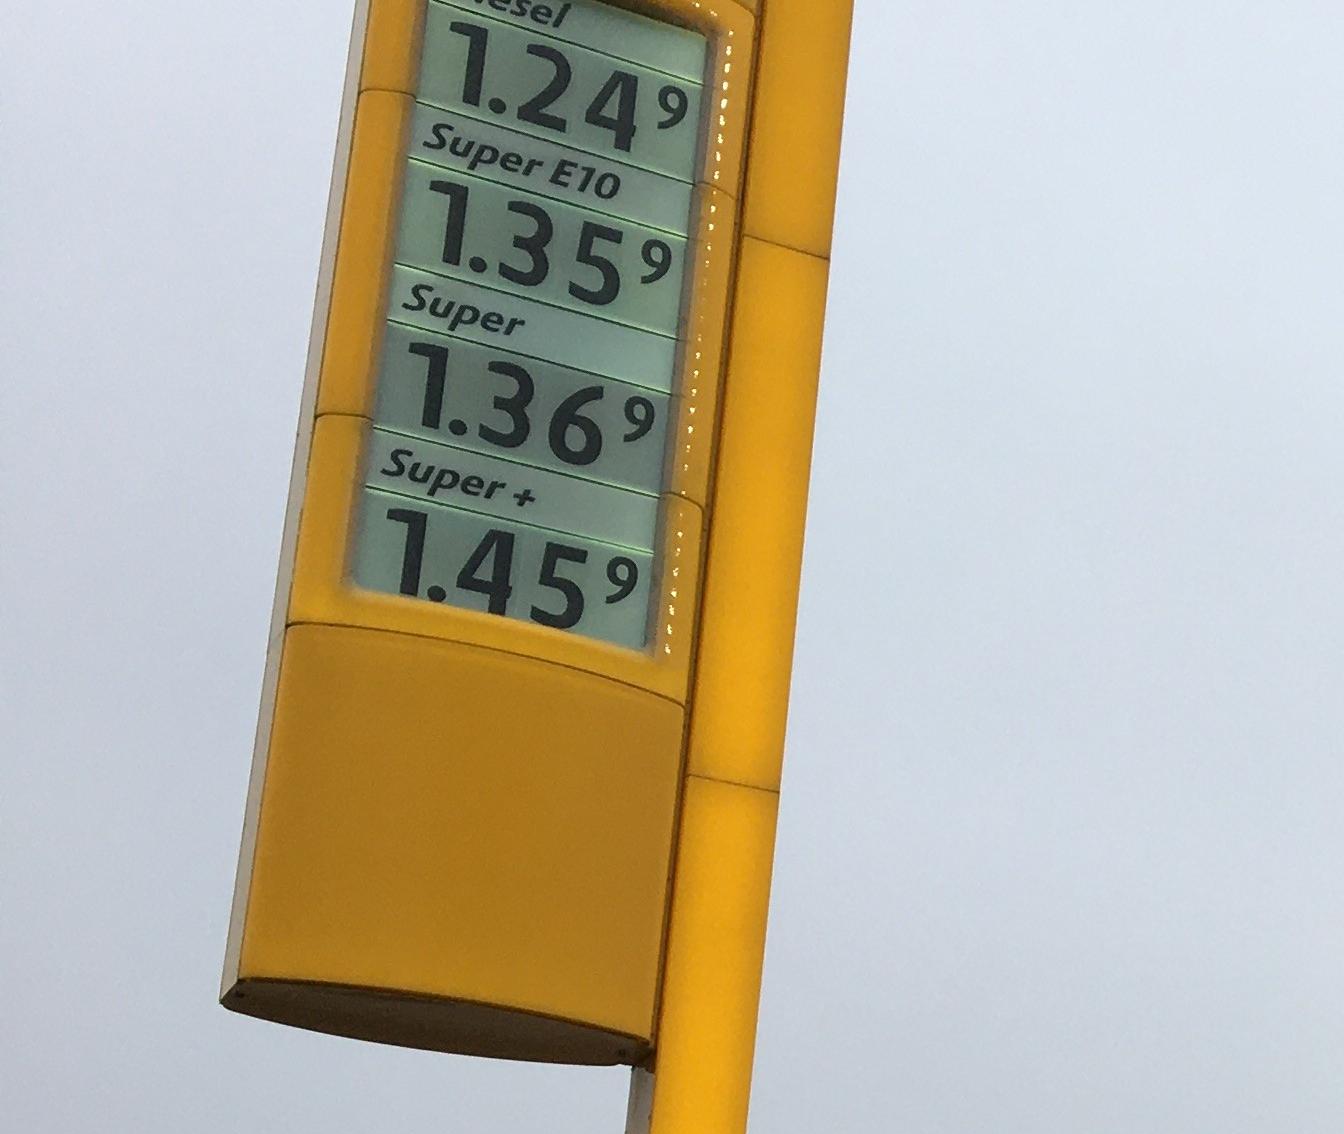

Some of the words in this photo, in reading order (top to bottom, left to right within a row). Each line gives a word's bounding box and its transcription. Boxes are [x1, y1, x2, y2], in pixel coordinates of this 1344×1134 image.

[474, 0, 571, 28] esel
[423, 122, 544, 178] Super
[549, 160, 621, 200] E10
[402, 283, 526, 336] Super
[380, 448, 505, 502] Super
